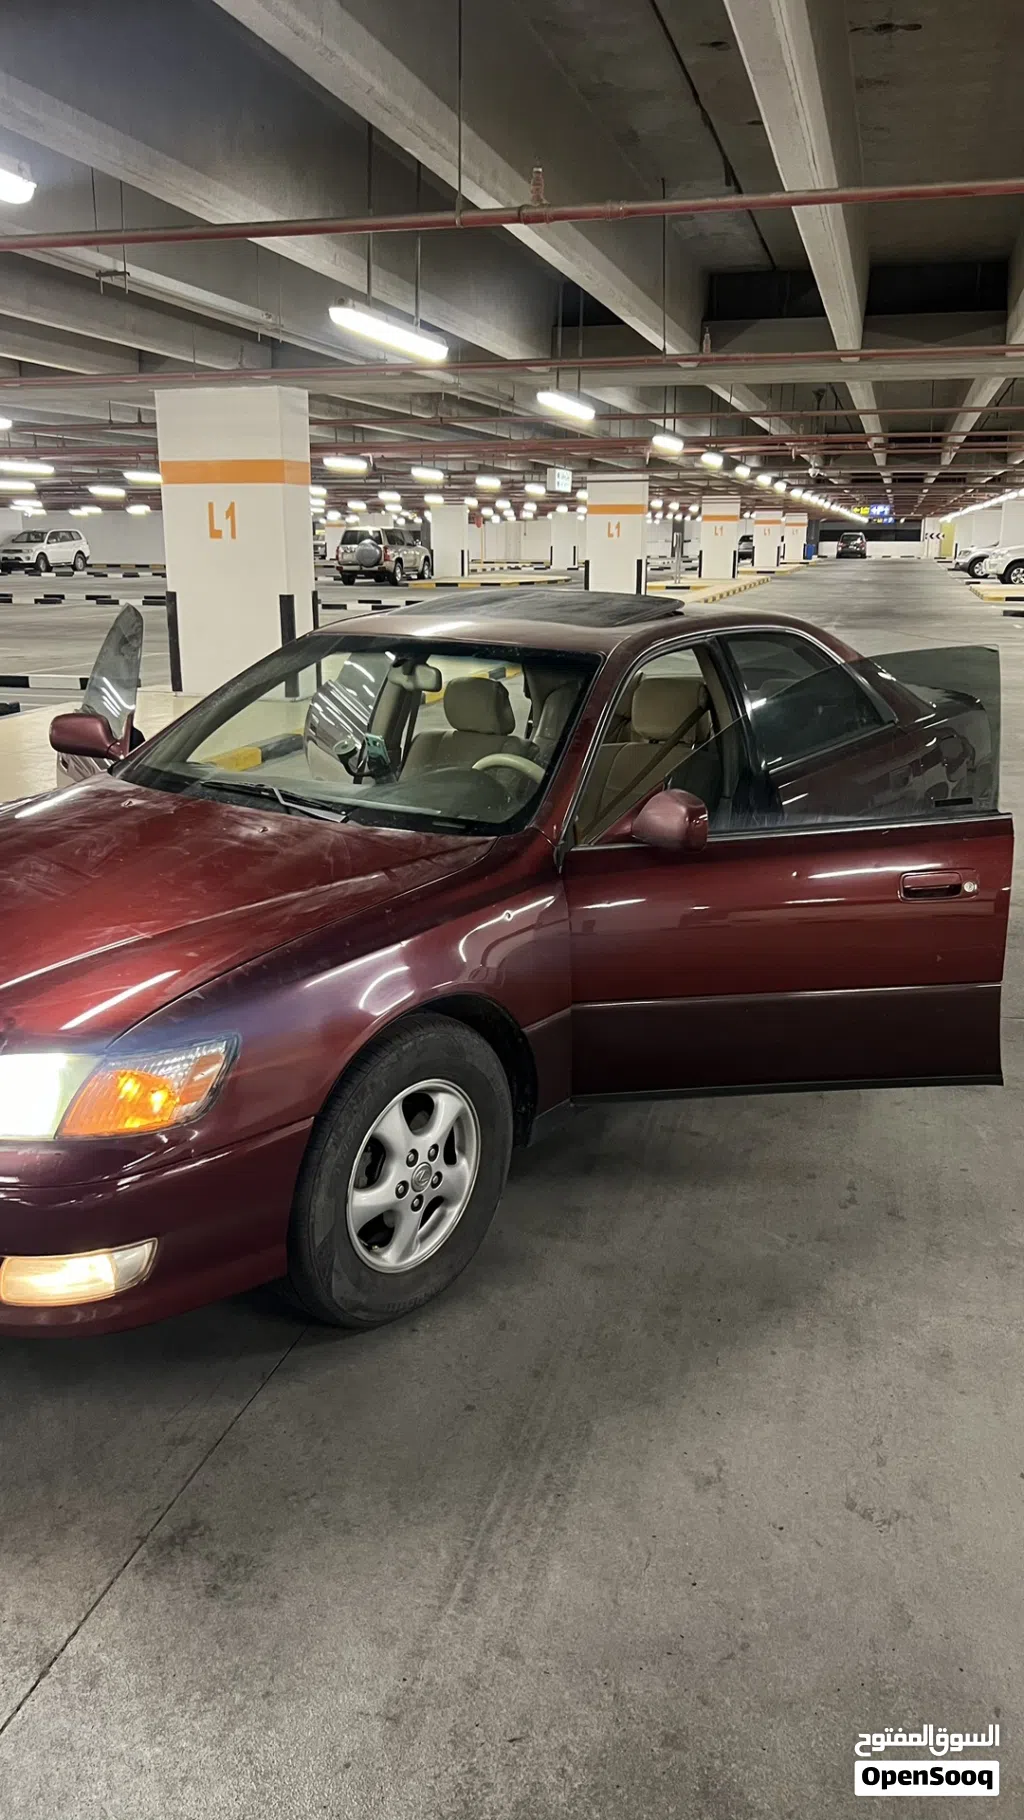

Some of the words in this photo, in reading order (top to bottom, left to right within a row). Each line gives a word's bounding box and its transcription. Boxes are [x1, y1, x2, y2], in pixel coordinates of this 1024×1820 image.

[208, 501, 236, 540] L1
[607, 521, 621, 538] L1
[714, 526, 724, 536] L1
[763, 527, 771, 536] L1
